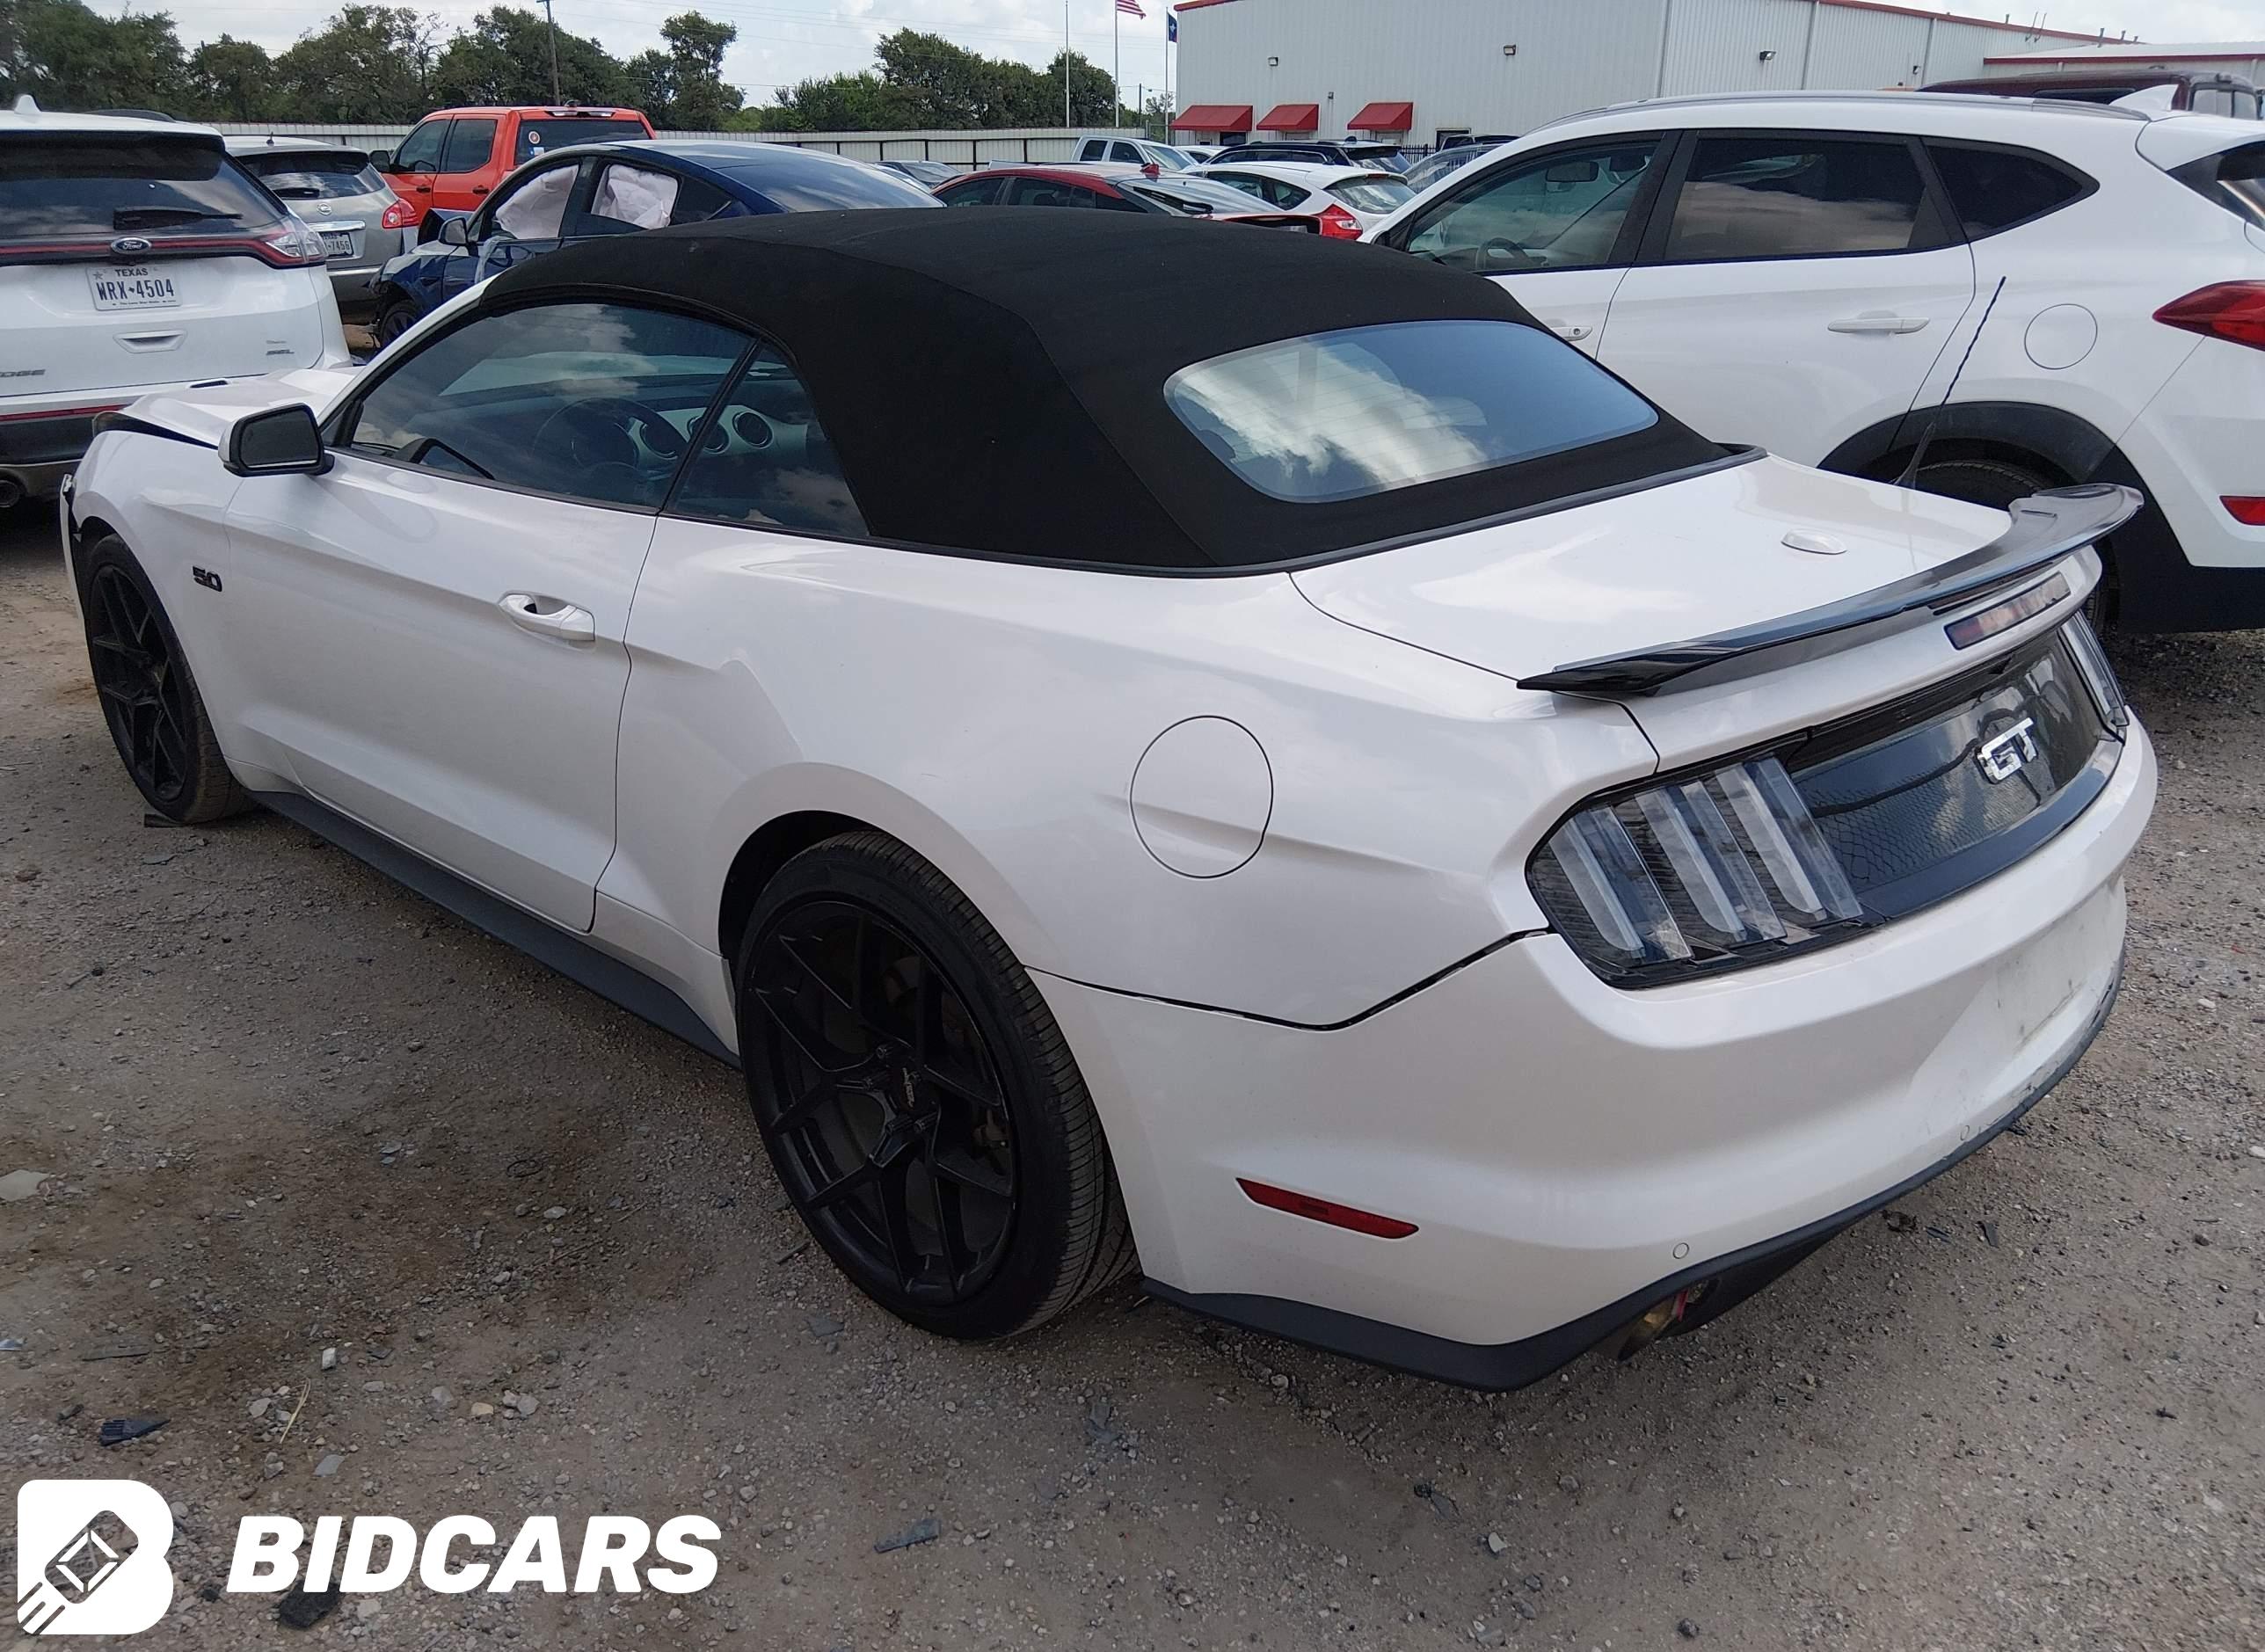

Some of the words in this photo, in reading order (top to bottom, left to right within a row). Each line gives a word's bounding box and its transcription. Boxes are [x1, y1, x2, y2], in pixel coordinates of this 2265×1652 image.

[123, 241, 142, 250] Ford
[114, 267, 149, 277] TEXAS
[1977, 717, 2037, 783] GT
